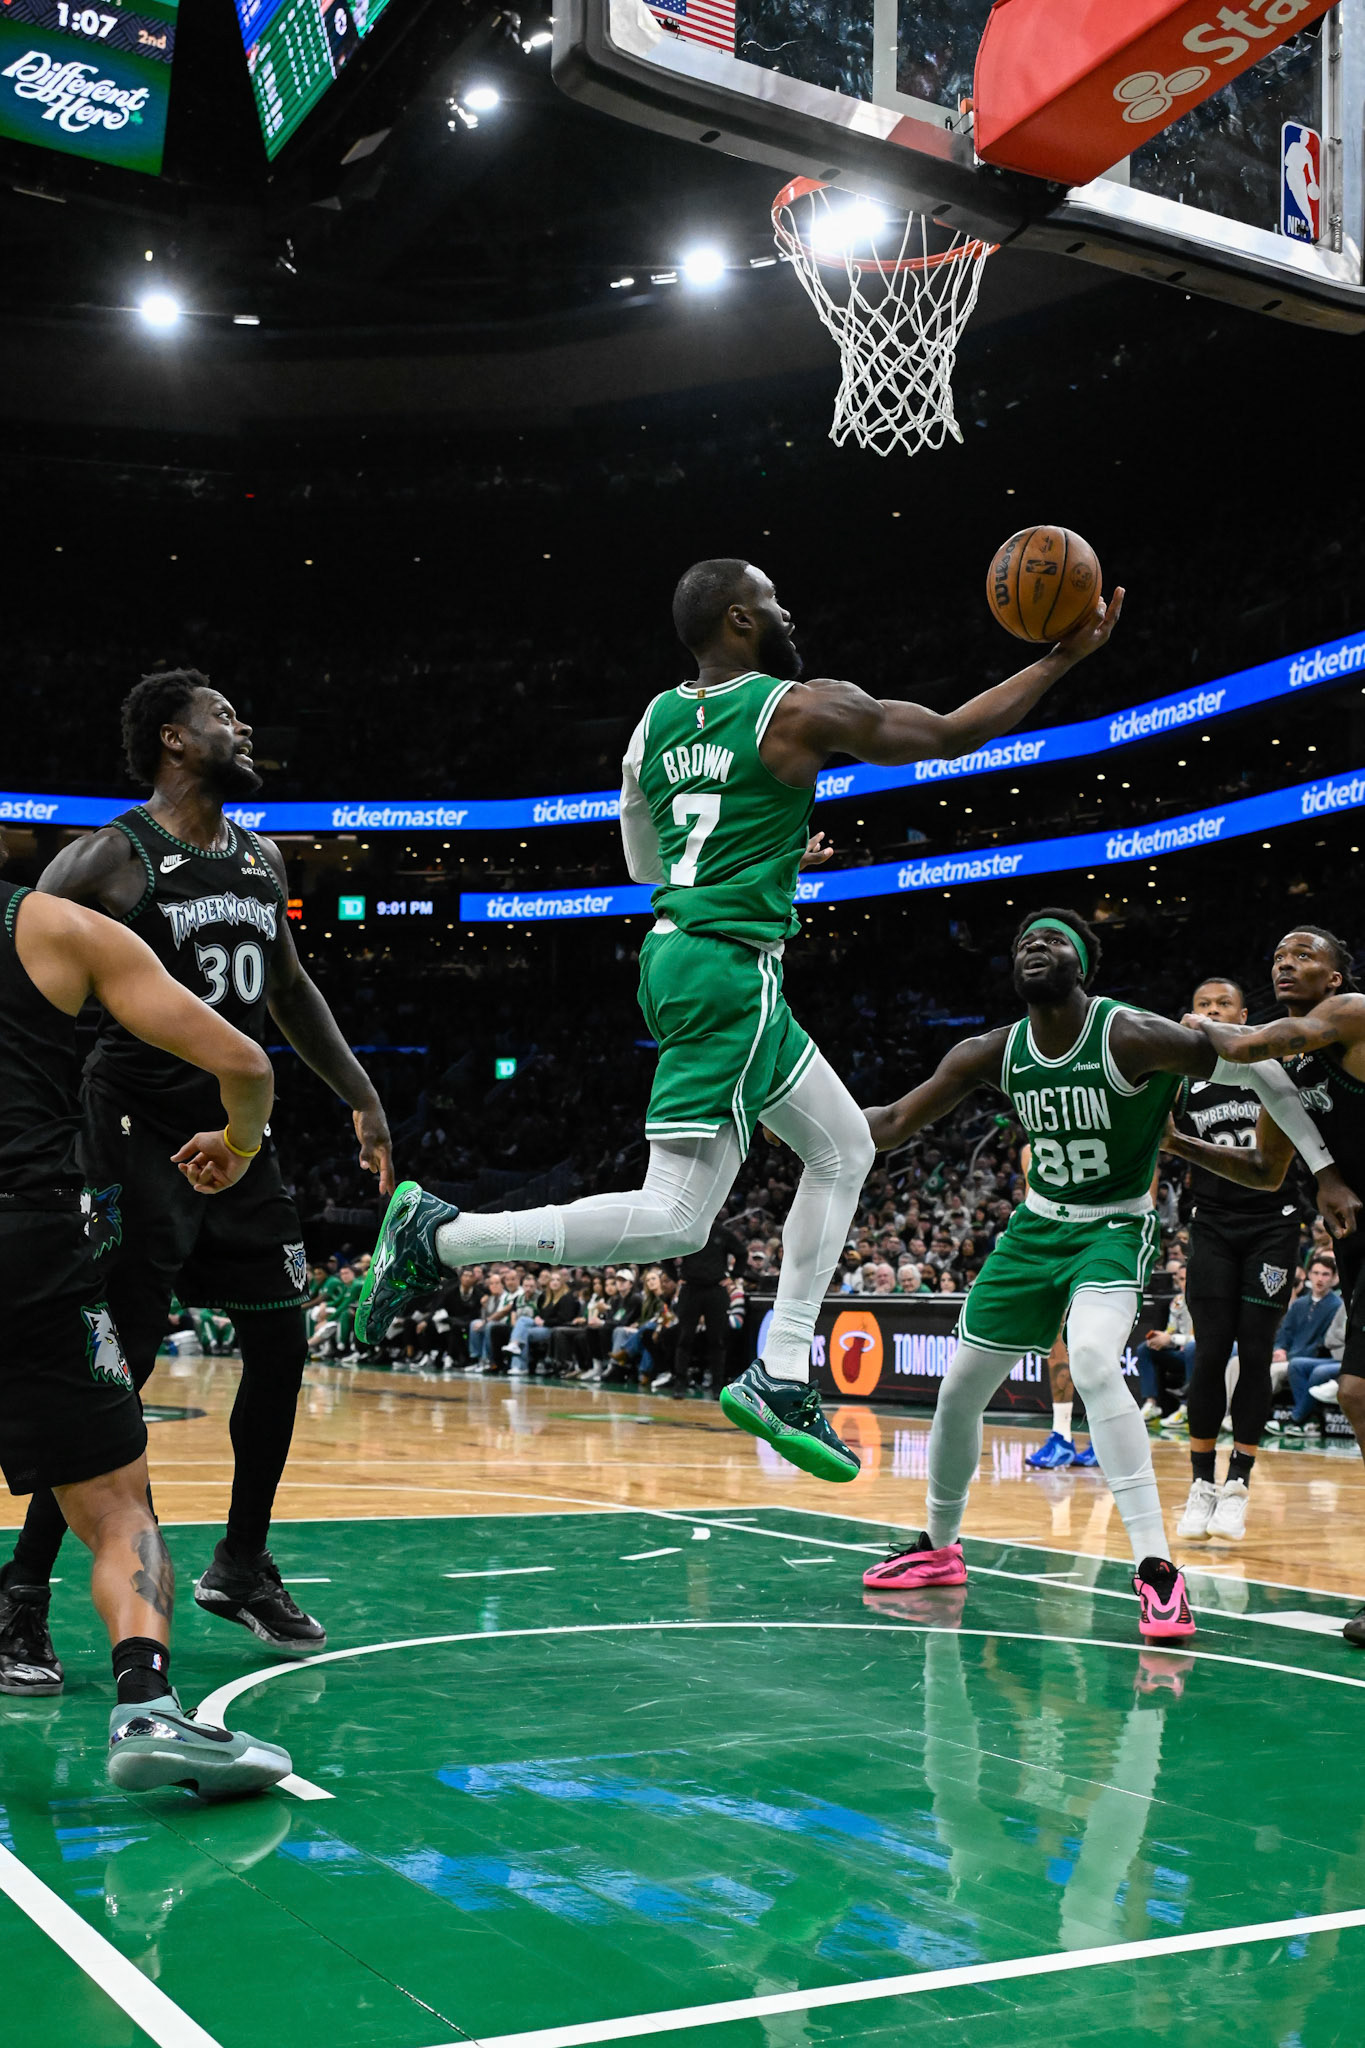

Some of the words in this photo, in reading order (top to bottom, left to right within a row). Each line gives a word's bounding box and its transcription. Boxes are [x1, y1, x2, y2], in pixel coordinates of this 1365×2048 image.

[57, 2, 118, 38] 1:07
[138, 29, 167, 49] 2nd
[1, 50, 150, 111] Different
[14, 81, 131, 133] Here
[1109, 689, 1226, 743] ticketmaster
[662, 743, 735, 785] BROWN
[332, 805, 468, 827] ticketmaster
[671, 793, 722, 887] 7
[1106, 816, 1225, 860] ticketmaster
[163, 854, 183, 866] NIKE
[241, 866, 268, 877] sezzle
[897, 854, 1023, 888] ticketmaster
[341, 900, 362, 915] TD
[377, 901, 405, 915] 9:01
[410, 901, 433, 915] PM
[487, 894, 613, 918] ticketmaster
[194, 941, 265, 1006] 30
[1072, 1061, 1100, 1072] Amica
[1013, 1086, 1111, 1132] BOSTON
[1186, 1100, 1262, 1138] TIMBERWOLVE
[1033, 1137, 1111, 1187] 88
